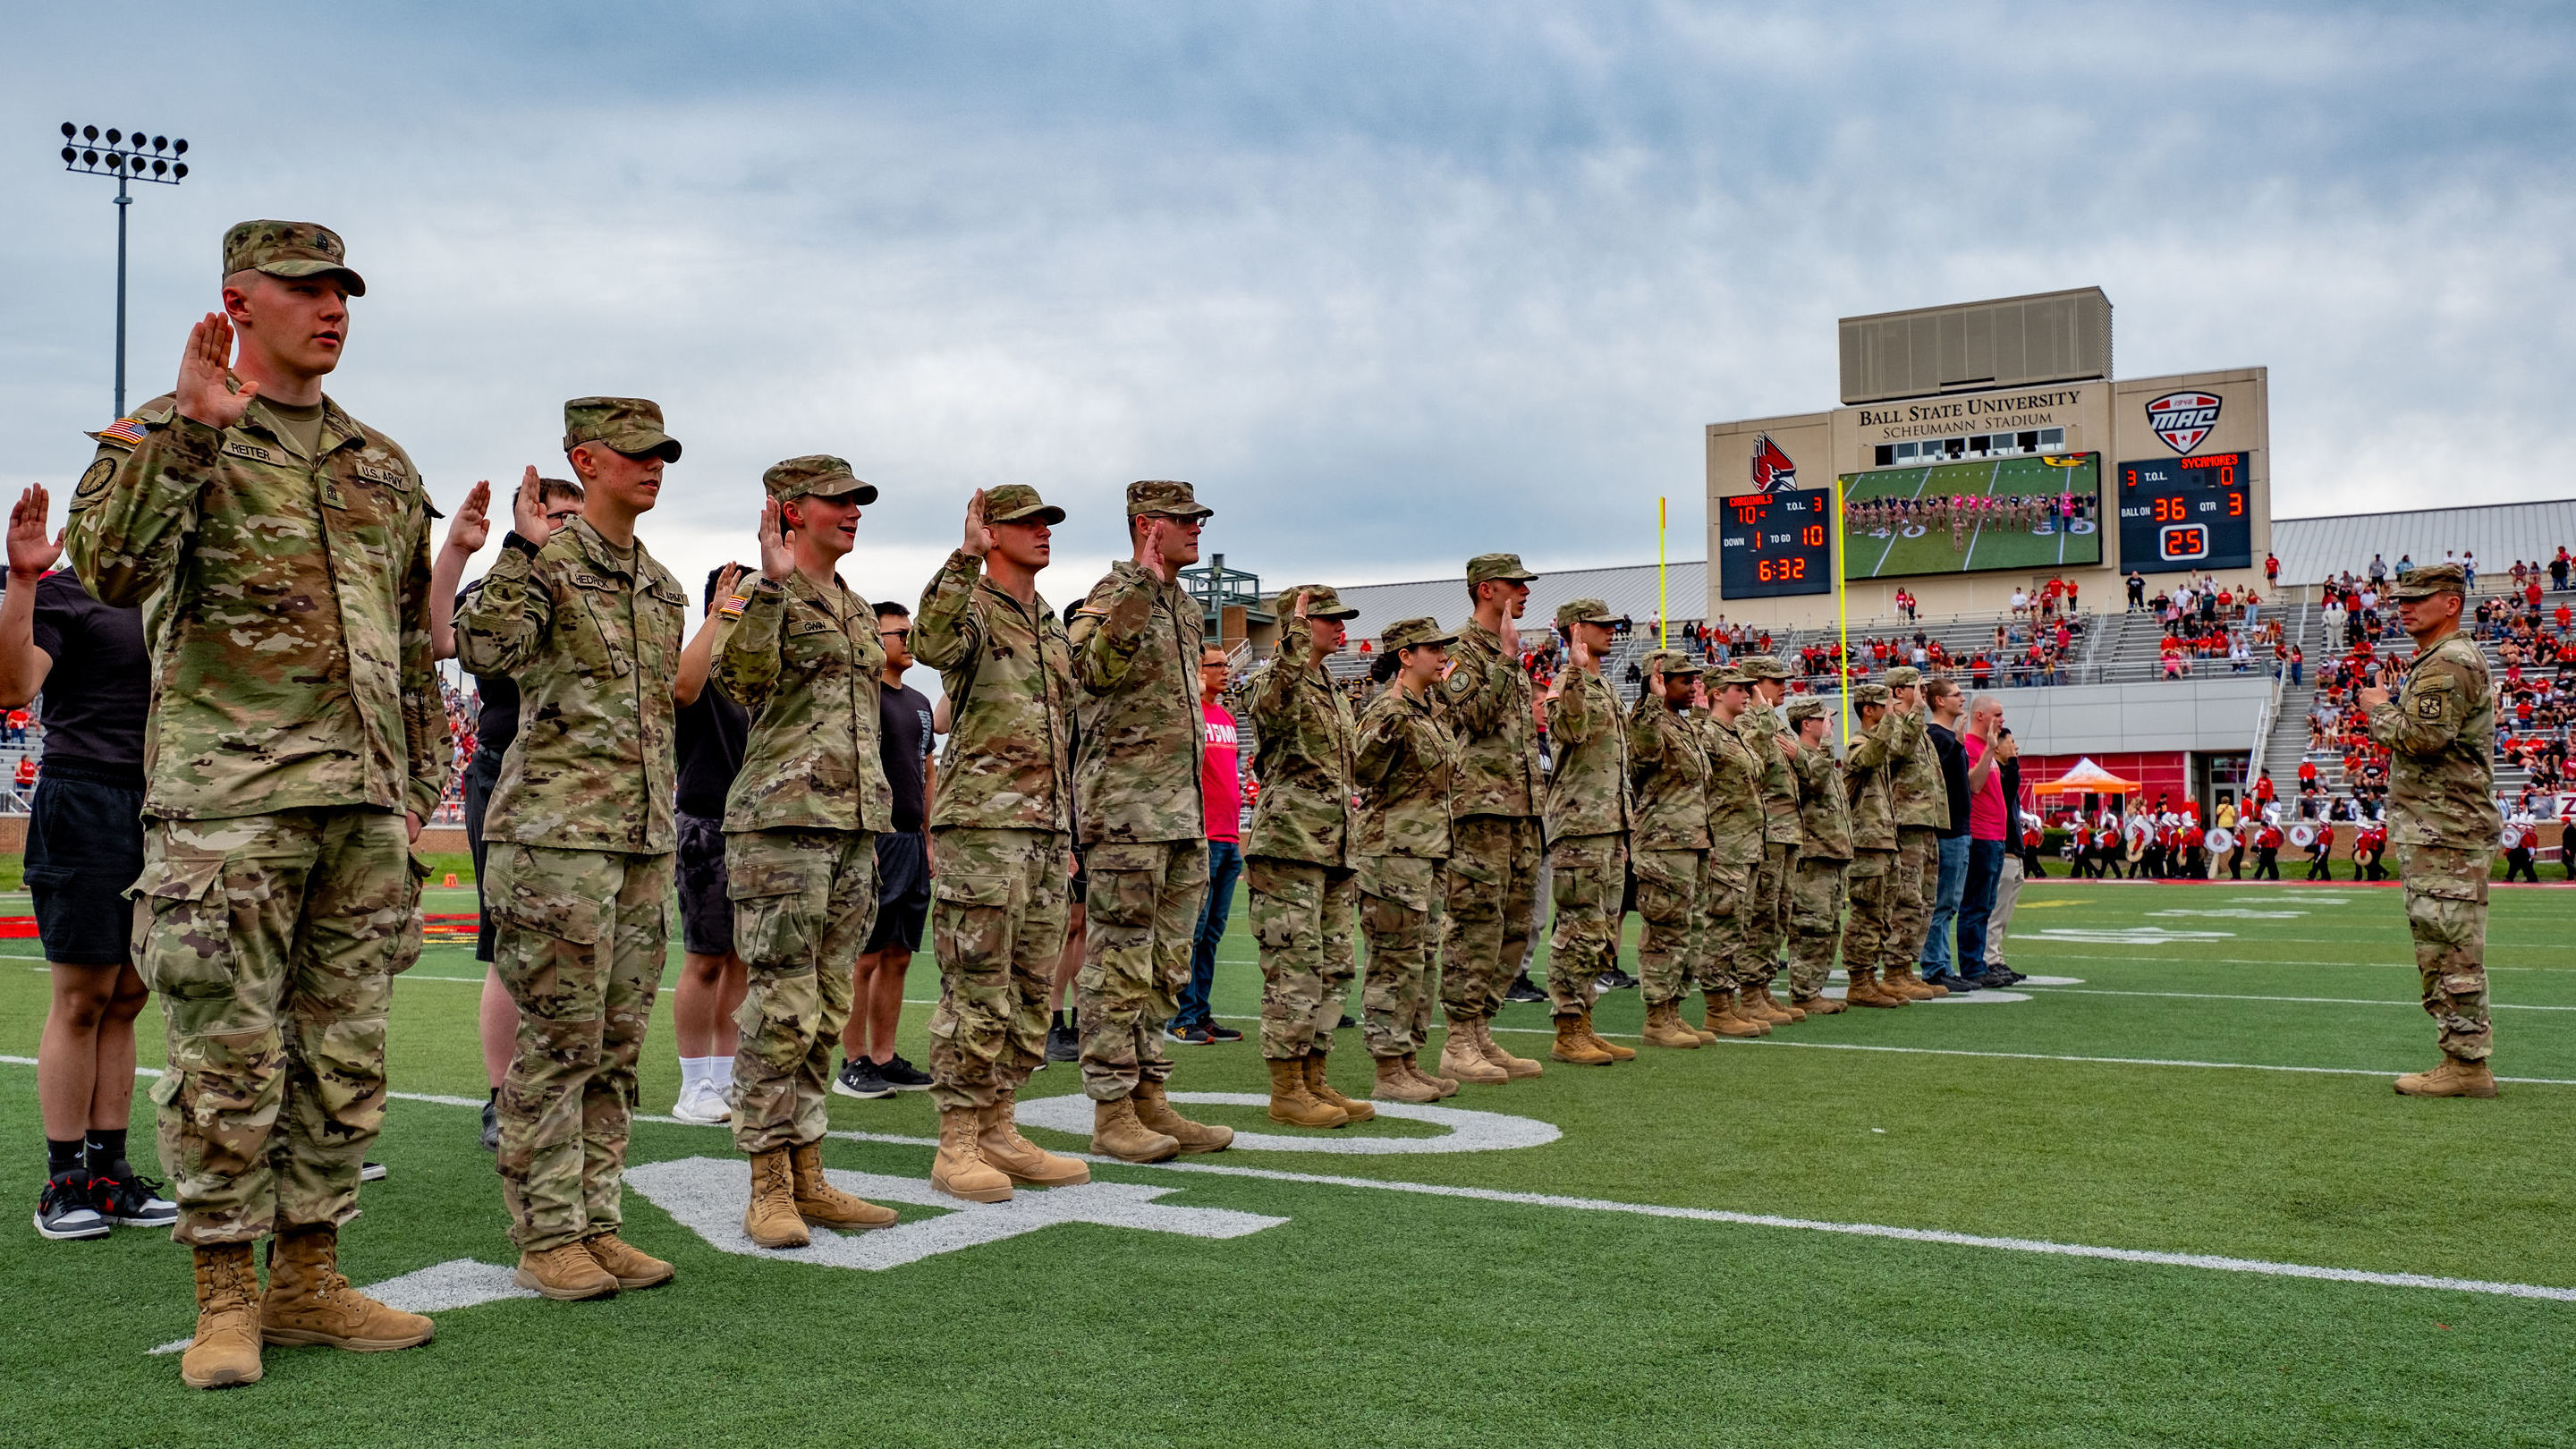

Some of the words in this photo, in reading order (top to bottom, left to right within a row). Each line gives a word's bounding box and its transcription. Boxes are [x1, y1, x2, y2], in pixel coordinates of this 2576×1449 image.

[1883, 419, 1977, 439] SCHEUMANN
[1985, 412, 2053, 429] STADIUM
[2151, 409, 2217, 430] MAC
[230, 442, 271, 462] REITER
[2181, 453, 2239, 470] SYCAMORES
[361, 465, 381, 479] U.S.
[382, 470, 403, 488] ARMY
[2126, 470, 2137, 487] 3
[2144, 471, 2168, 482] T.O.L.
[2220, 466, 2233, 486] 0
[1785, 502, 1807, 511] T.O.L.
[1813, 496, 1822, 512] 3
[2121, 507, 2139, 517] BALL
[2140, 506, 2151, 516] ON
[2155, 496, 2186, 521] 36
[2199, 502, 2216, 512] QTR
[2228, 493, 2242, 516] 3
[1739, 506, 1756, 524] 10
[1724, 538, 1745, 547] DOWN
[1756, 530, 1761, 549] 1
[1770, 535, 1780, 544] TO
[1781, 534, 1791, 543] GO
[1802, 525, 1823, 547] 10
[2167, 530, 2201, 555] 25
[1758, 557, 1805, 582] 6:32
